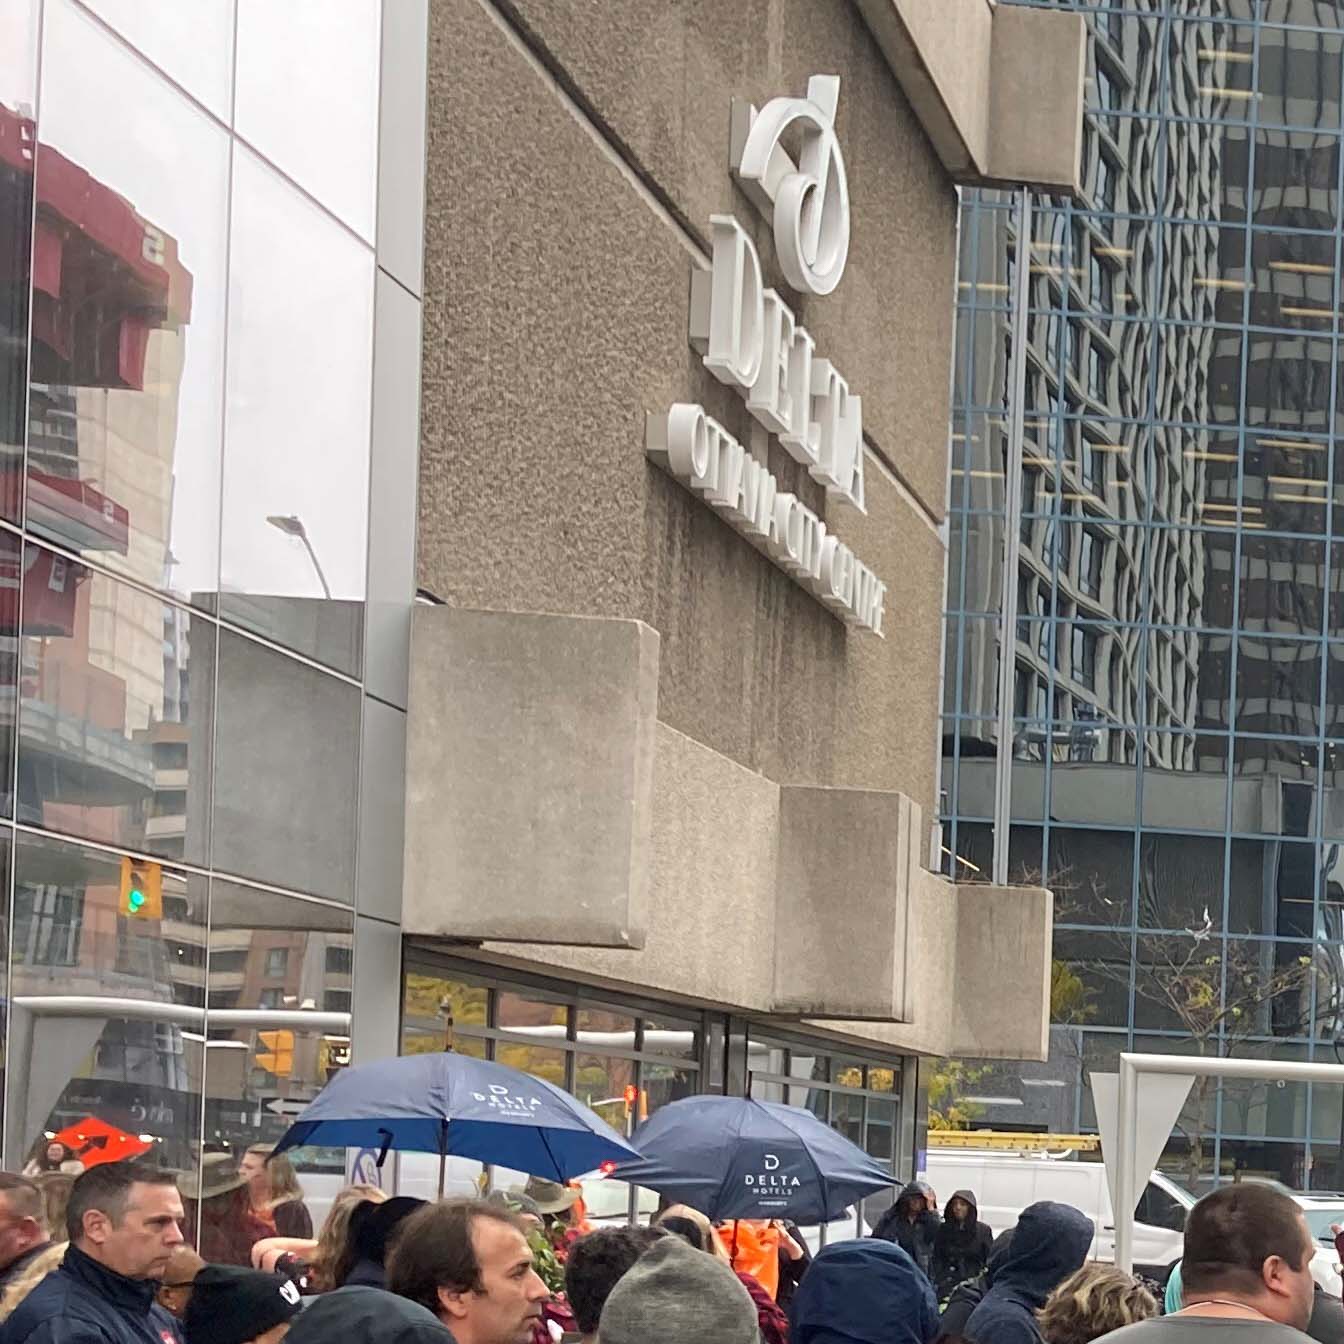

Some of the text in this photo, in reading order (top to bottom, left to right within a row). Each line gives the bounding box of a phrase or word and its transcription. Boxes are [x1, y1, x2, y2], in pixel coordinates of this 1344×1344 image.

[703, 214, 868, 517] DELTA
[473, 1092, 542, 1105] DELTA
[745, 1174, 800, 1186] DELTA
[752, 1187, 793, 1196] HOTELS
